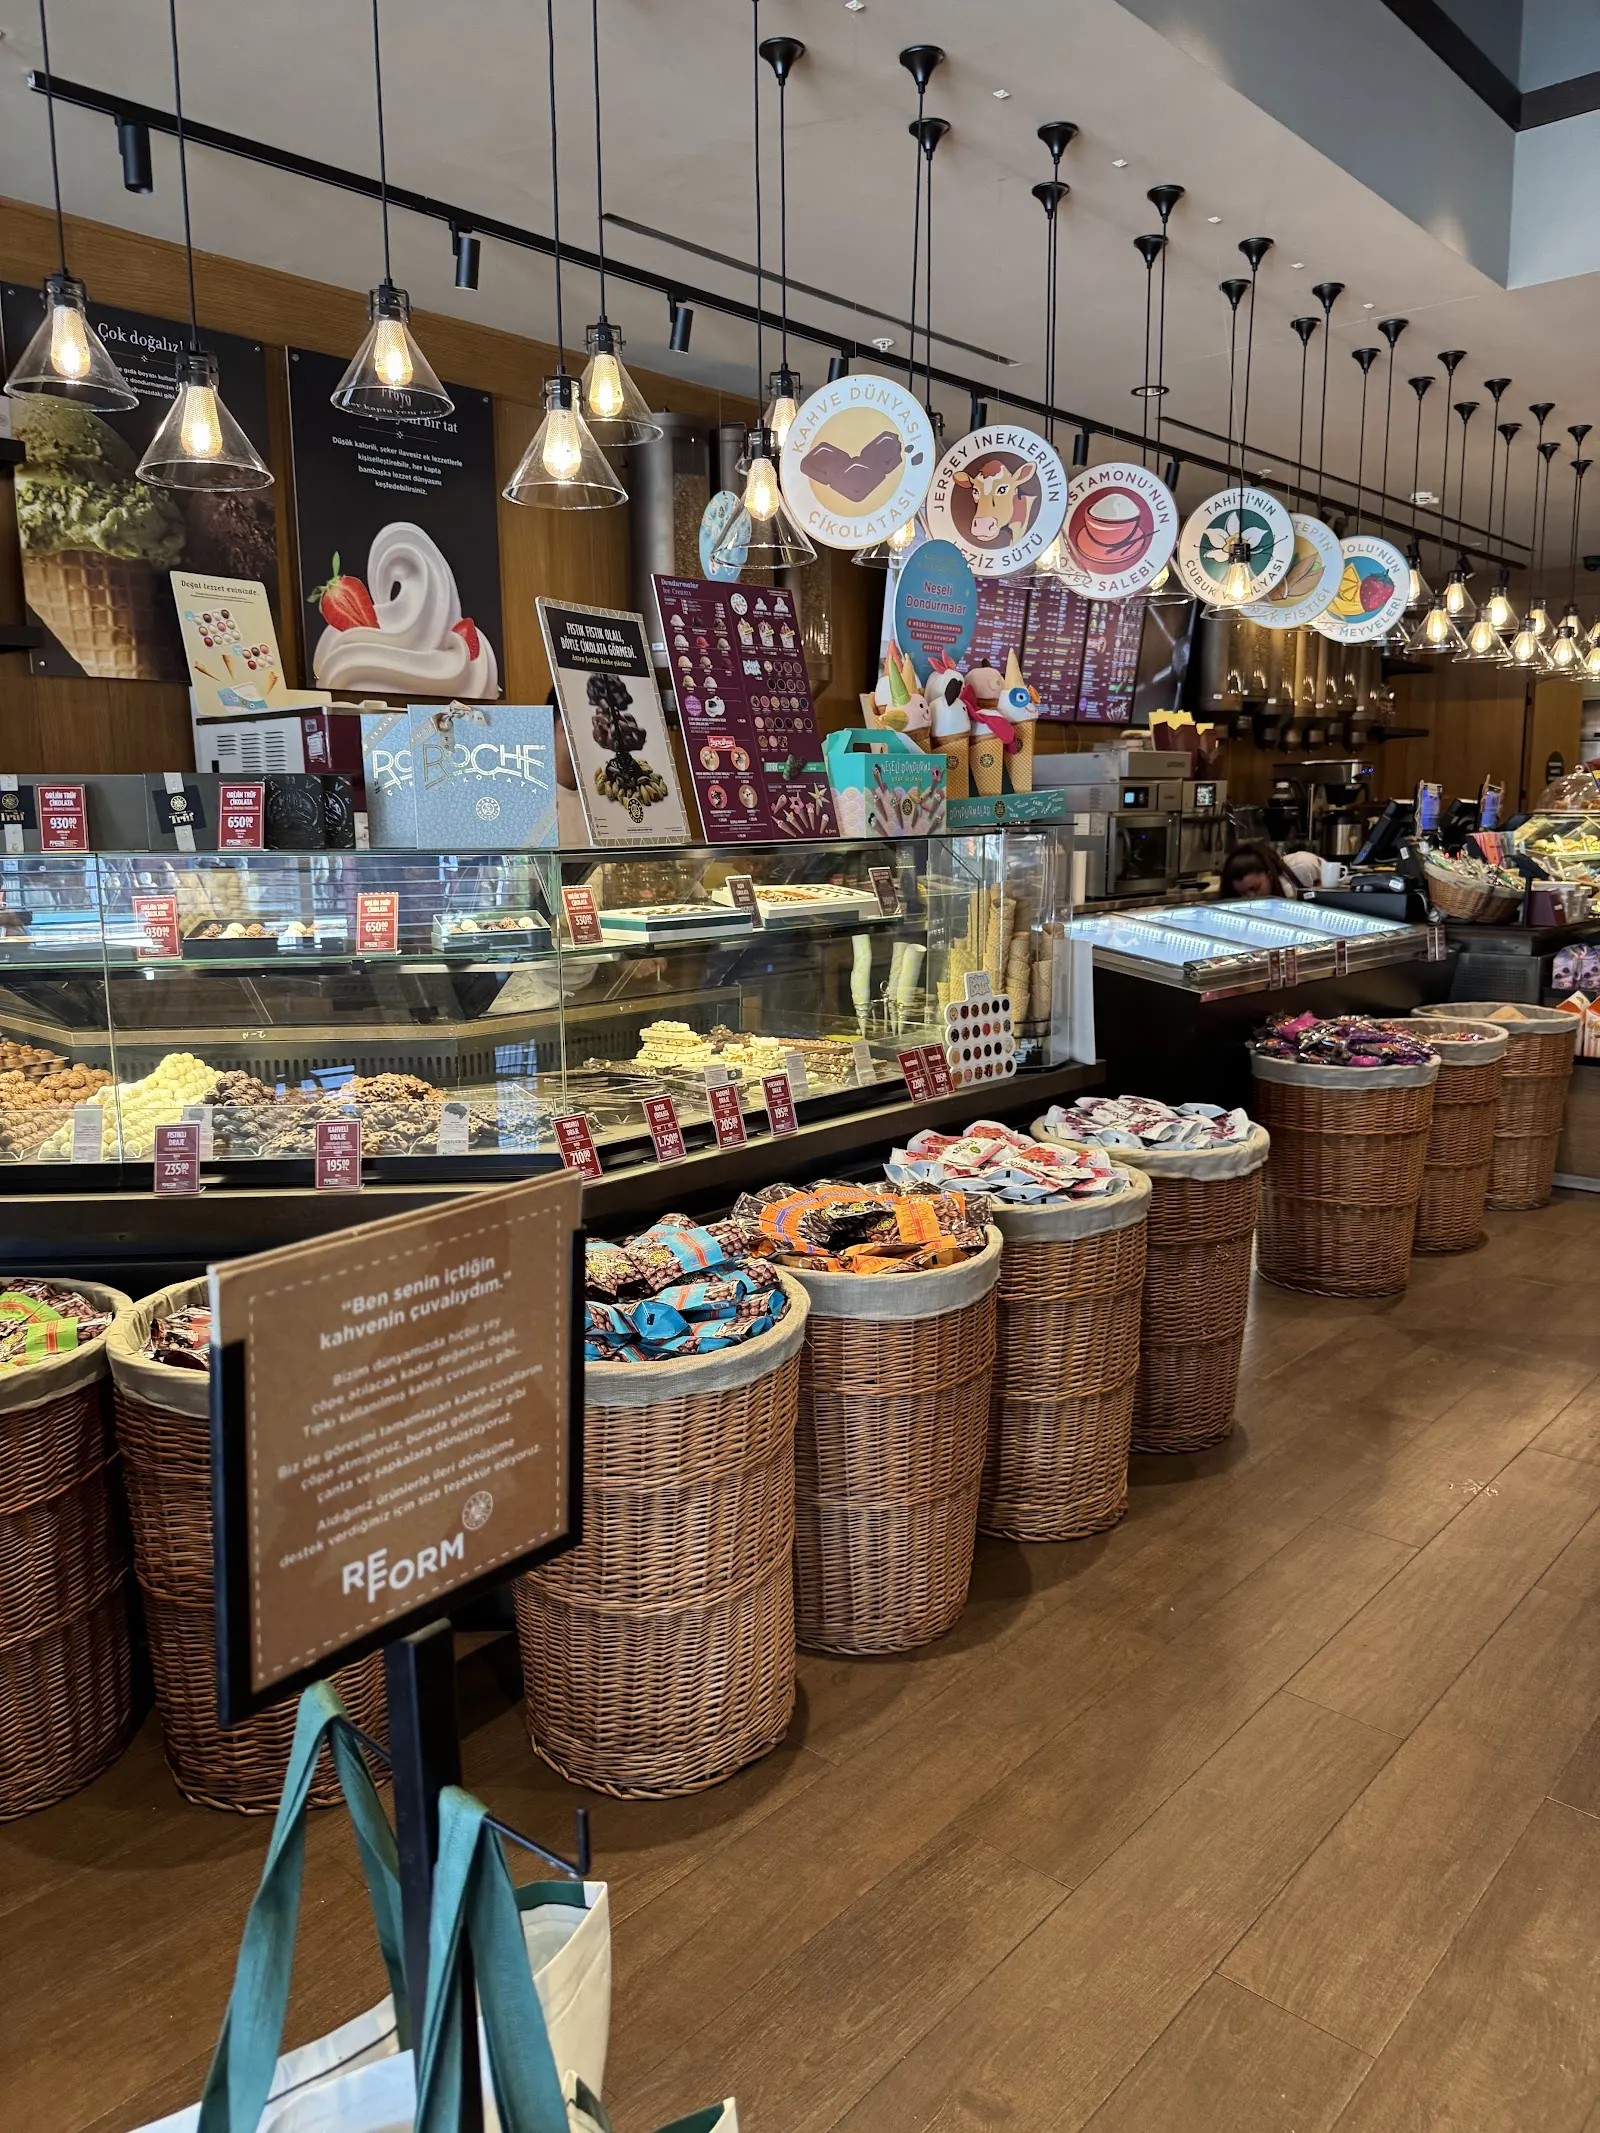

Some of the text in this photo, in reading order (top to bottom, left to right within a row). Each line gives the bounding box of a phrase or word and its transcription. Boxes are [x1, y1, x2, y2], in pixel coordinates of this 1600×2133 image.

[97, 322, 127, 342] Çok
[443, 421, 458, 433] tat
[793, 384, 922, 454] KAHVE DÜNYASI
[332, 436, 463, 468] Düşük kalorili, şeker ilavesiz ek lezzetlerle
[357, 453, 441, 475] kişiselleştirebilir, her kapta
[933, 433, 1062, 513] JERSEY İNEKLERİNİN
[358, 465, 443, 487] bambaşka lezzet dünyasını
[375, 480, 428, 496] keşfedebilirsiniz.
[1067, 470, 1170, 524] STAMONU'NUN
[808, 489, 915, 538] ÇİKOLATASI
[1002, 532, 1044, 567] SÜTÜ
[661, 578, 699, 589] Dondurmalar
[1098, 559, 1155, 592] SALEBİ
[1185, 560, 1217, 597] ÇUBUK
[204, 582, 224, 592] lezzet
[671, 589, 692, 597] Creams
[924, 580, 953, 597] Neşeli
[906, 595, 967, 615] Dondurmalar
[1284, 588, 1331, 622] FISTIĞI
[565, 622, 585, 636] FISTIK
[585, 626, 604, 640] FISTIK
[560, 635, 637, 659] BÖYLE ÇİKOLATA GÖRMEDİ.
[422, 743, 549, 791] ROCHE
[881, 759, 931, 775] NEŞELİ DONDURMA
[49, 799, 74, 807] ÇİKOLATA
[64, 791, 77, 800] TRÜF
[229, 798, 253, 806] ÇİKOLATA
[244, 790, 257, 798] TRÜF
[50, 817, 68, 829] 930
[168, 811, 195, 824] Trüf
[228, 816, 245, 828] 650
[146, 927, 162, 937] 930
[365, 922, 381, 932] 650
[167, 1131, 187, 1139] FISTIKLI
[327, 1125, 349, 1133] KAHVELİ
[330, 1133, 346, 1141] DRAJE
[567, 1128, 580, 1136] DRAJE
[326, 1159, 342, 1171] 195
[570, 1150, 584, 1166] 210
[164, 1163, 180, 1175] 235
[393, 1274, 439, 1301] senin
[444, 1256, 495, 1284] içtiğin
[320, 1310, 405, 1350] kahvenin
[332, 1317, 501, 1386] Bizim dünyamızda hiçbir şey
[311, 1394, 344, 1416] çöpe
[348, 1373, 397, 1400] atılacak
[401, 1361, 434, 1380] kadar
[437, 1340, 485, 1366] değersiz
[303, 1418, 336, 1438] Tıpkı
[338, 1390, 405, 1423] kullanılmış
[408, 1375, 443, 1396] kahve
[445, 1357, 493, 1382] çuvalları
[277, 1363, 543, 1480] Biz de görevini tamamlayan kahve çuvallarını
[301, 1468, 334, 1491] çöpe
[406, 1420, 448, 1445] burada
[450, 1397, 503, 1428] gördünüz
[505, 1386, 527, 1405] gibi
[316, 1480, 353, 1503] çanta
[356, 1472, 371, 1484] ve
[375, 1446, 432, 1478] şapkalara
[317, 1438, 515, 1532] Aldığınız ürünlerle ileri dönüşüme
[279, 1540, 324, 1569] destek
[327, 1510, 391, 1546] verdiğiniz
[393, 1500, 415, 1518] için
[418, 1488, 441, 1505] size
[443, 1466, 491, 1494] teşekkür
[342, 1532, 464, 1603] REFORM
